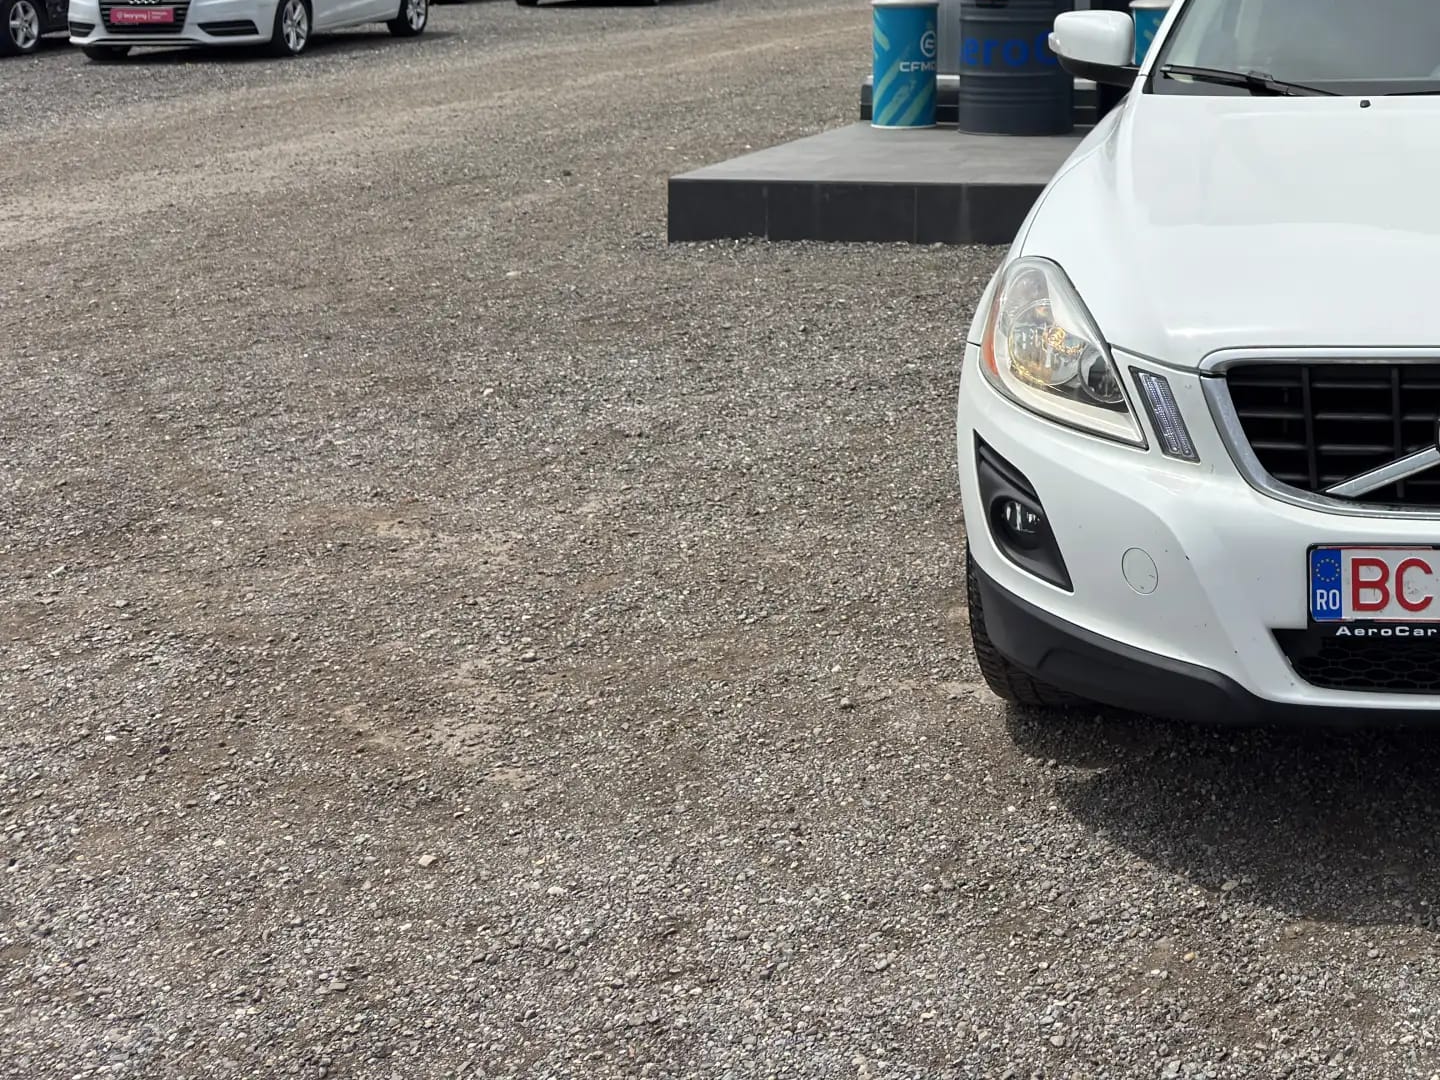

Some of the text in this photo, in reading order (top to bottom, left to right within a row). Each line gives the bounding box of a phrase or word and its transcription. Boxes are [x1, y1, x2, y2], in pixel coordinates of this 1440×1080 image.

[961, 29, 1058, 67] eroC
[1316, 589, 1340, 611] RO
[1351, 557, 1434, 613] BC
